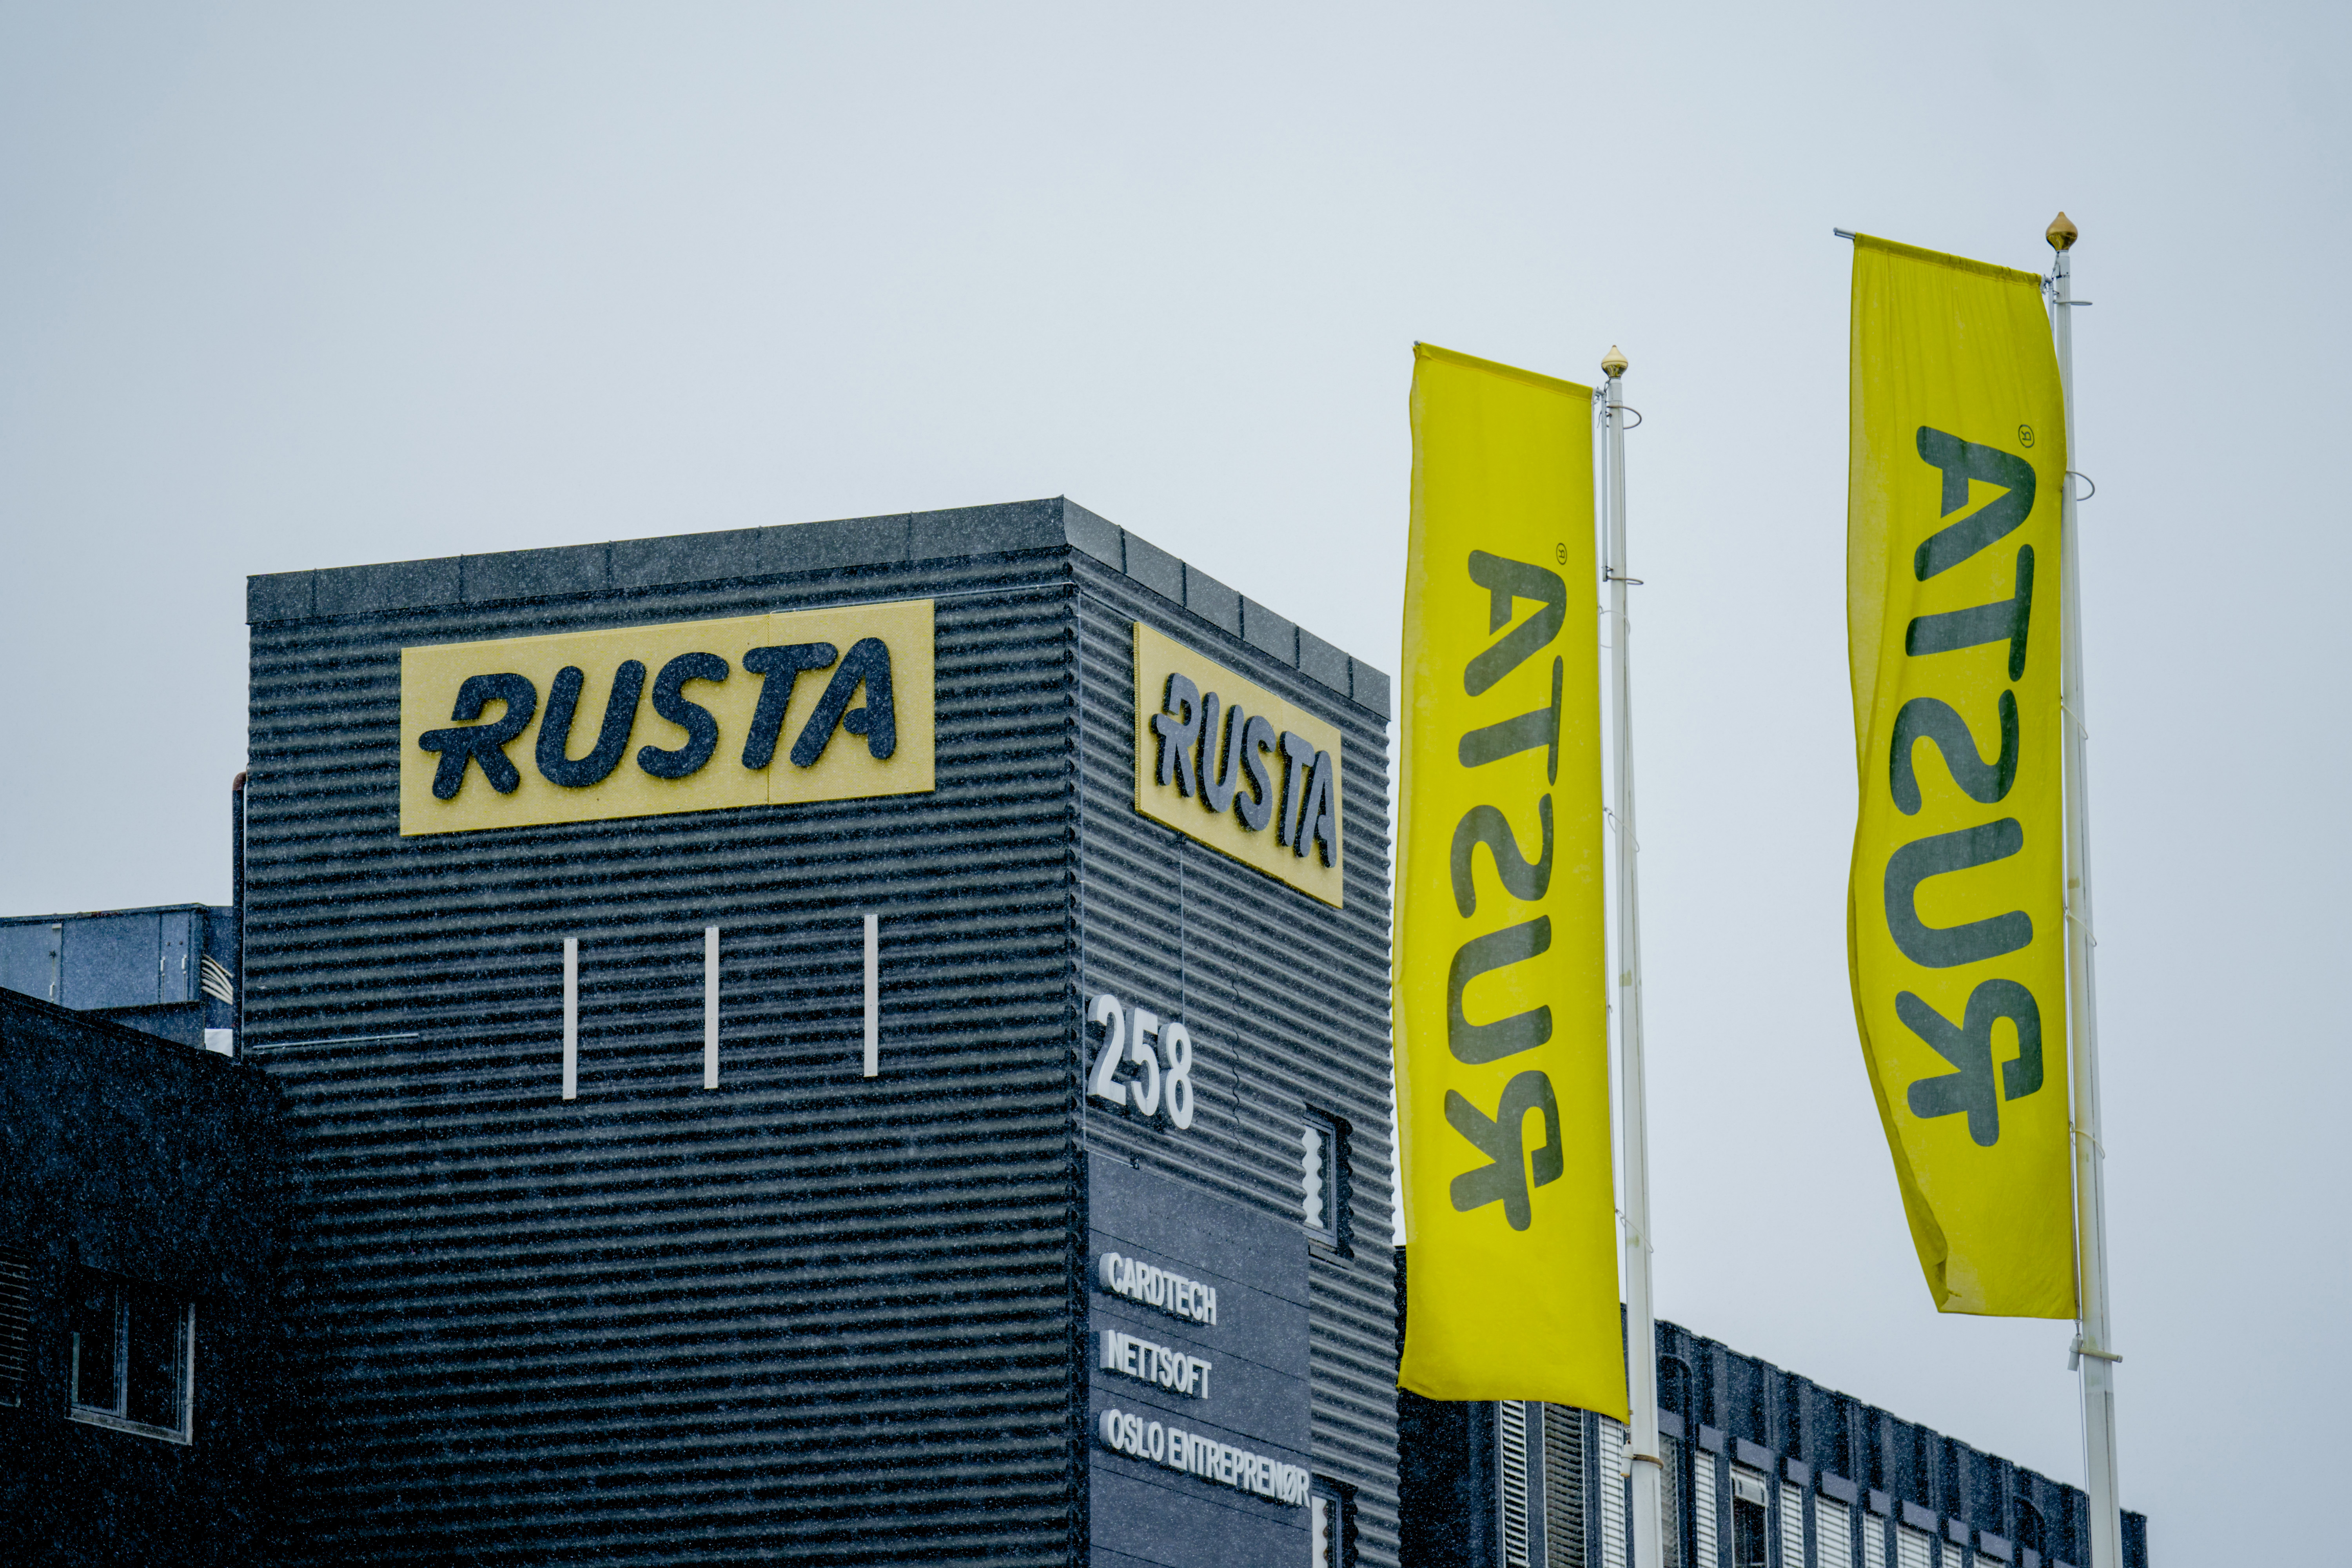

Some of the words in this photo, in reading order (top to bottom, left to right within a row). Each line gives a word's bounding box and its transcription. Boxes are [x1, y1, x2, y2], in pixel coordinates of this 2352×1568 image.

[418, 637, 897, 800] RUSTA
[1151, 672, 1337, 867] RUSTA
[1087, 993, 1194, 1130] 258
[1099, 1252, 1216, 1325] CARDTECH
[1100, 1330, 1211, 1399] NETTSOFT
[1100, 1409, 1164, 1462] OSLO
[1168, 1427, 1310, 1508] ENTREPRENØR
